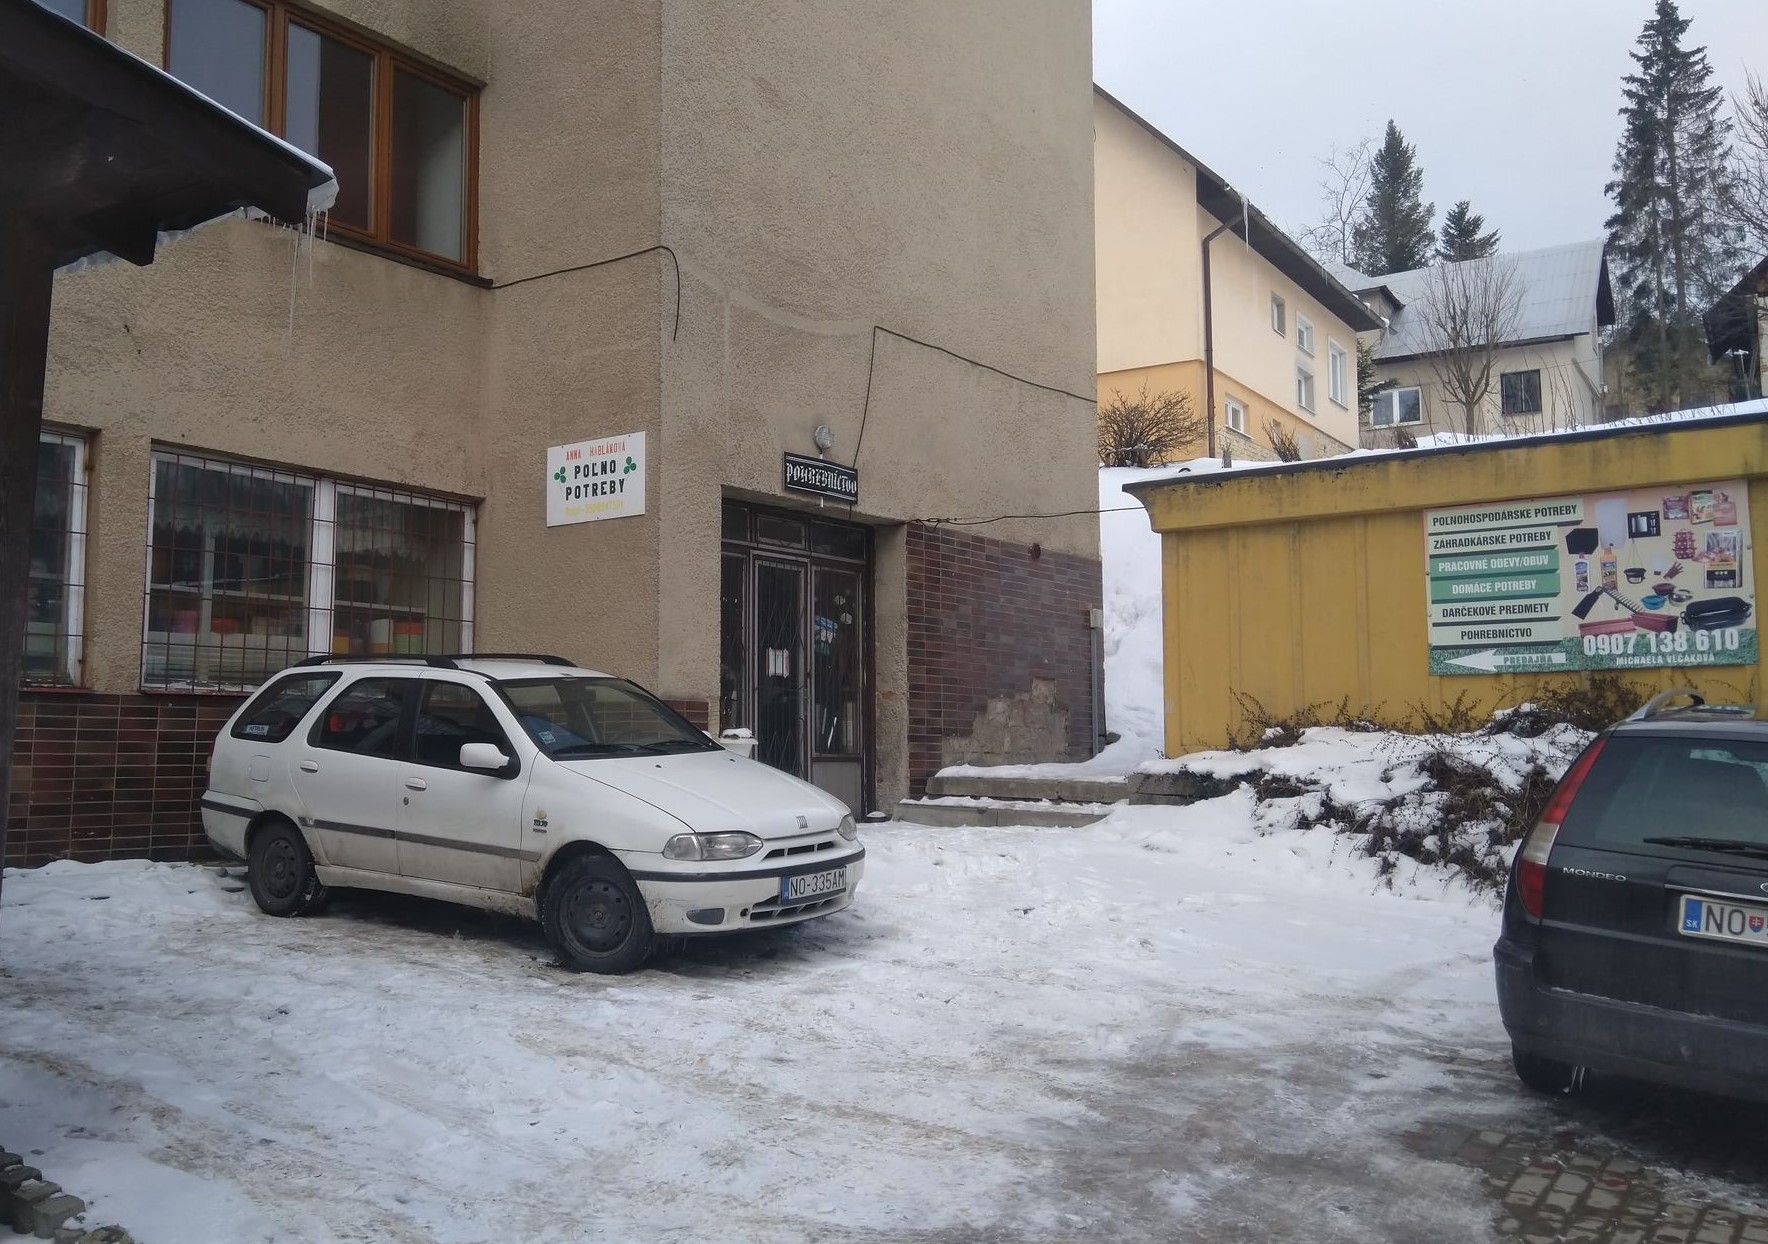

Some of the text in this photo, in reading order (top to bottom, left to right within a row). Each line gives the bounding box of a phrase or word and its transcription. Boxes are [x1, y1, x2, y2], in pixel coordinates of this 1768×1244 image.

[566, 449, 581, 461] ANNA
[574, 459, 616, 480] POĽNO
[565, 478, 625, 501] POTREBY
[1433, 504, 1577, 527] POĽNOHOSPODÁRSKE POTREBY
[1509, 531, 1551, 545] POTREBY
[1438, 554, 1549, 573] PRACOVNÉ ODEVY/OBUV
[1452, 579, 1537, 595] DOMÁCE POTREBY
[1442, 602, 1549, 618] DARČEKOVÉ PREDMETY
[1461, 627, 1532, 641] POHREBNÍCTVO
[1583, 628, 1739, 656] 0907 138 610
[1616, 655, 1663, 666] MICHAELA
[1562, 866, 1627, 882] MONDEO
[790, 870, 845, 897] NO-335AM
[1685, 919, 1698, 929] SK
